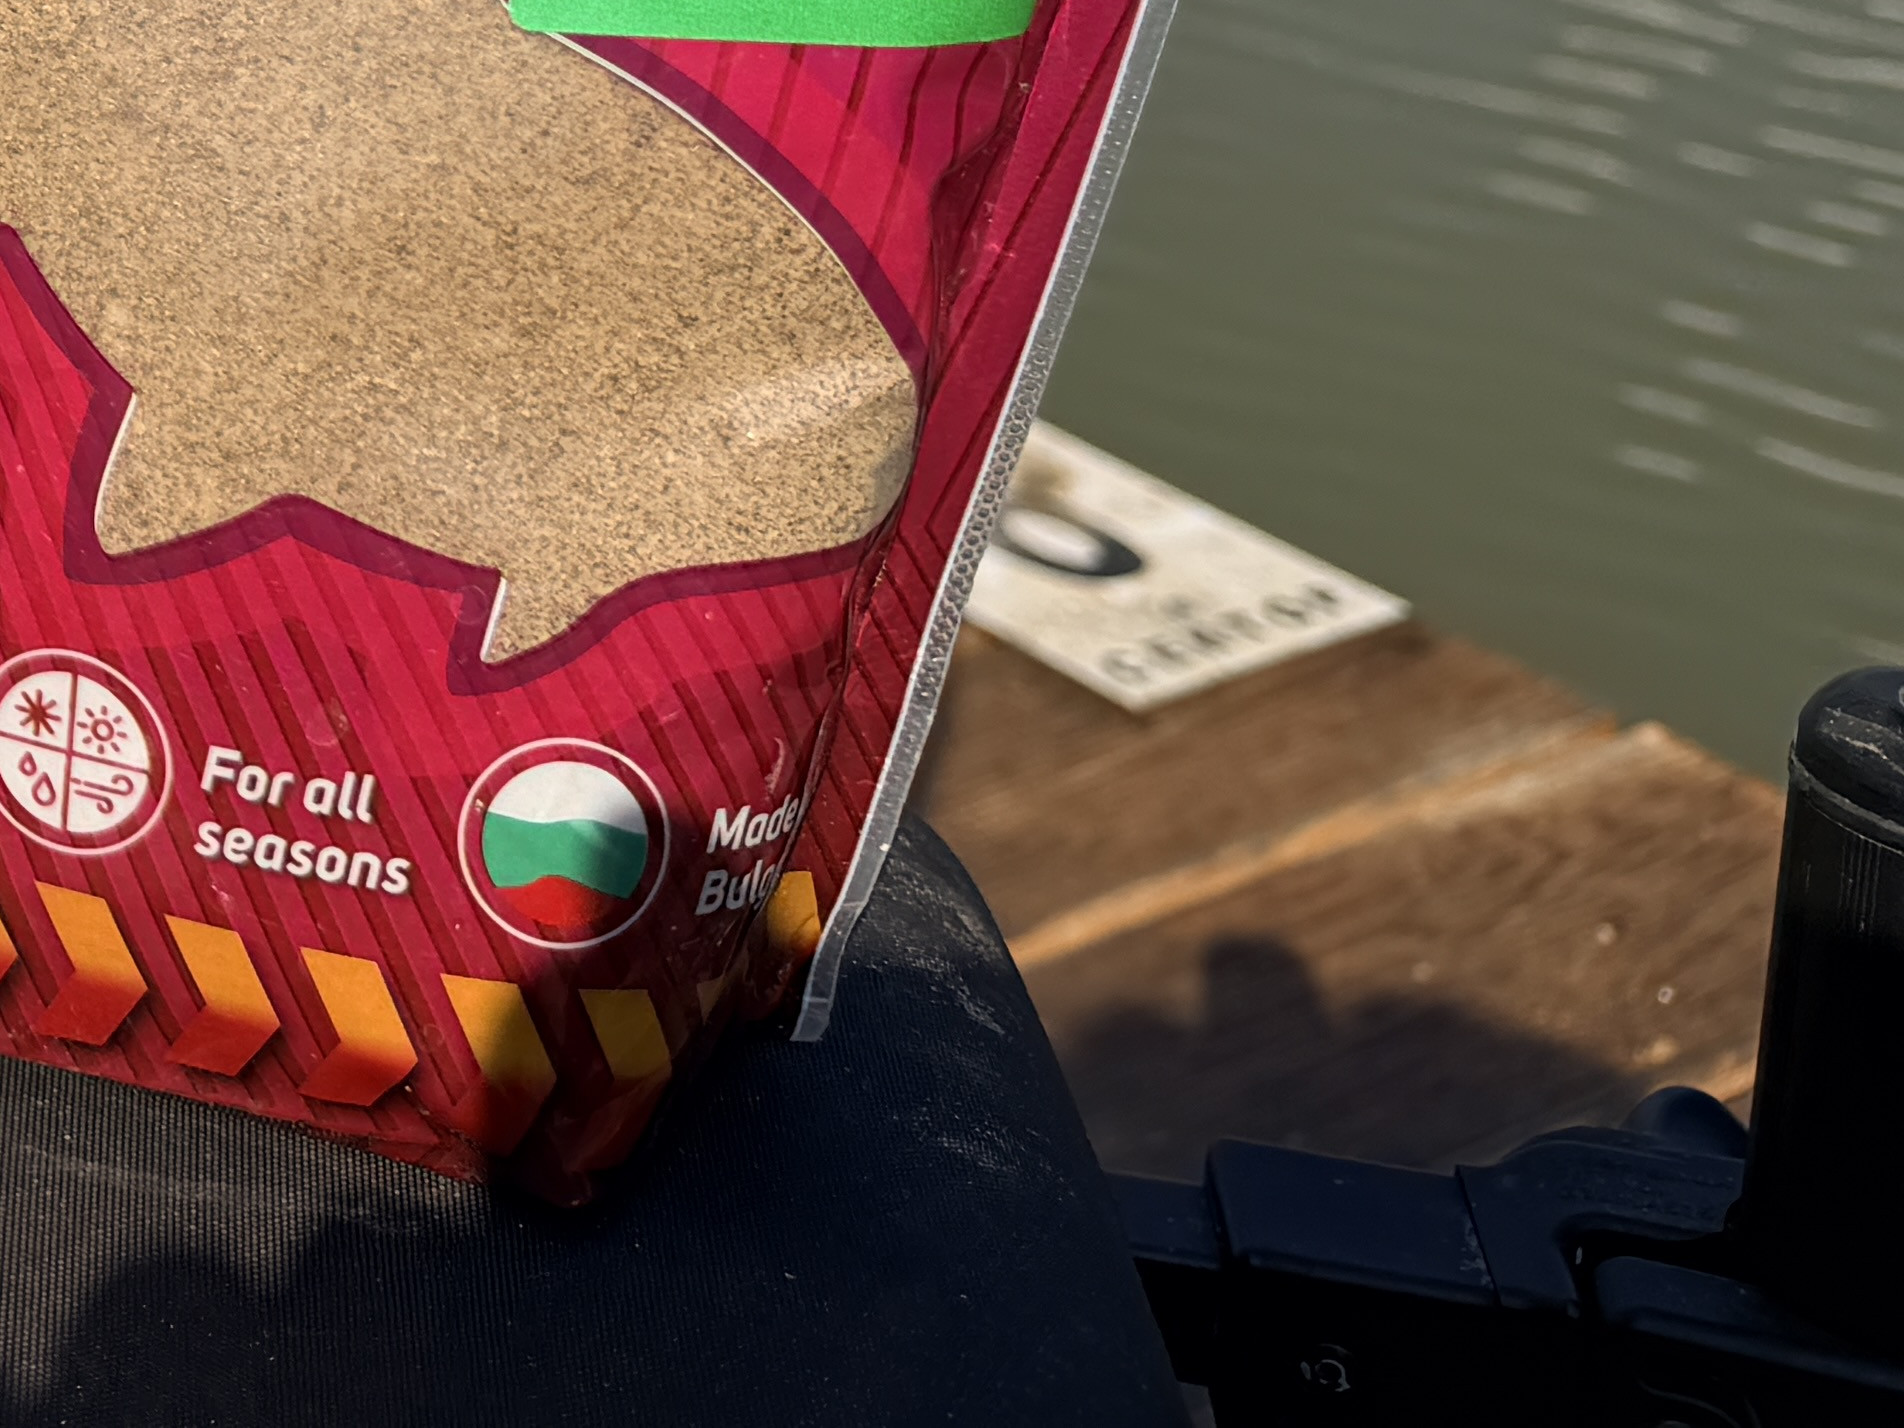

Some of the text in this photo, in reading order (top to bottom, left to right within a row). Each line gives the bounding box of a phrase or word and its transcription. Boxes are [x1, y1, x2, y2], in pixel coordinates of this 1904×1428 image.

[200, 744, 376, 825] For all
[193, 820, 412, 895] seasons
[705, 793, 800, 855] Made
